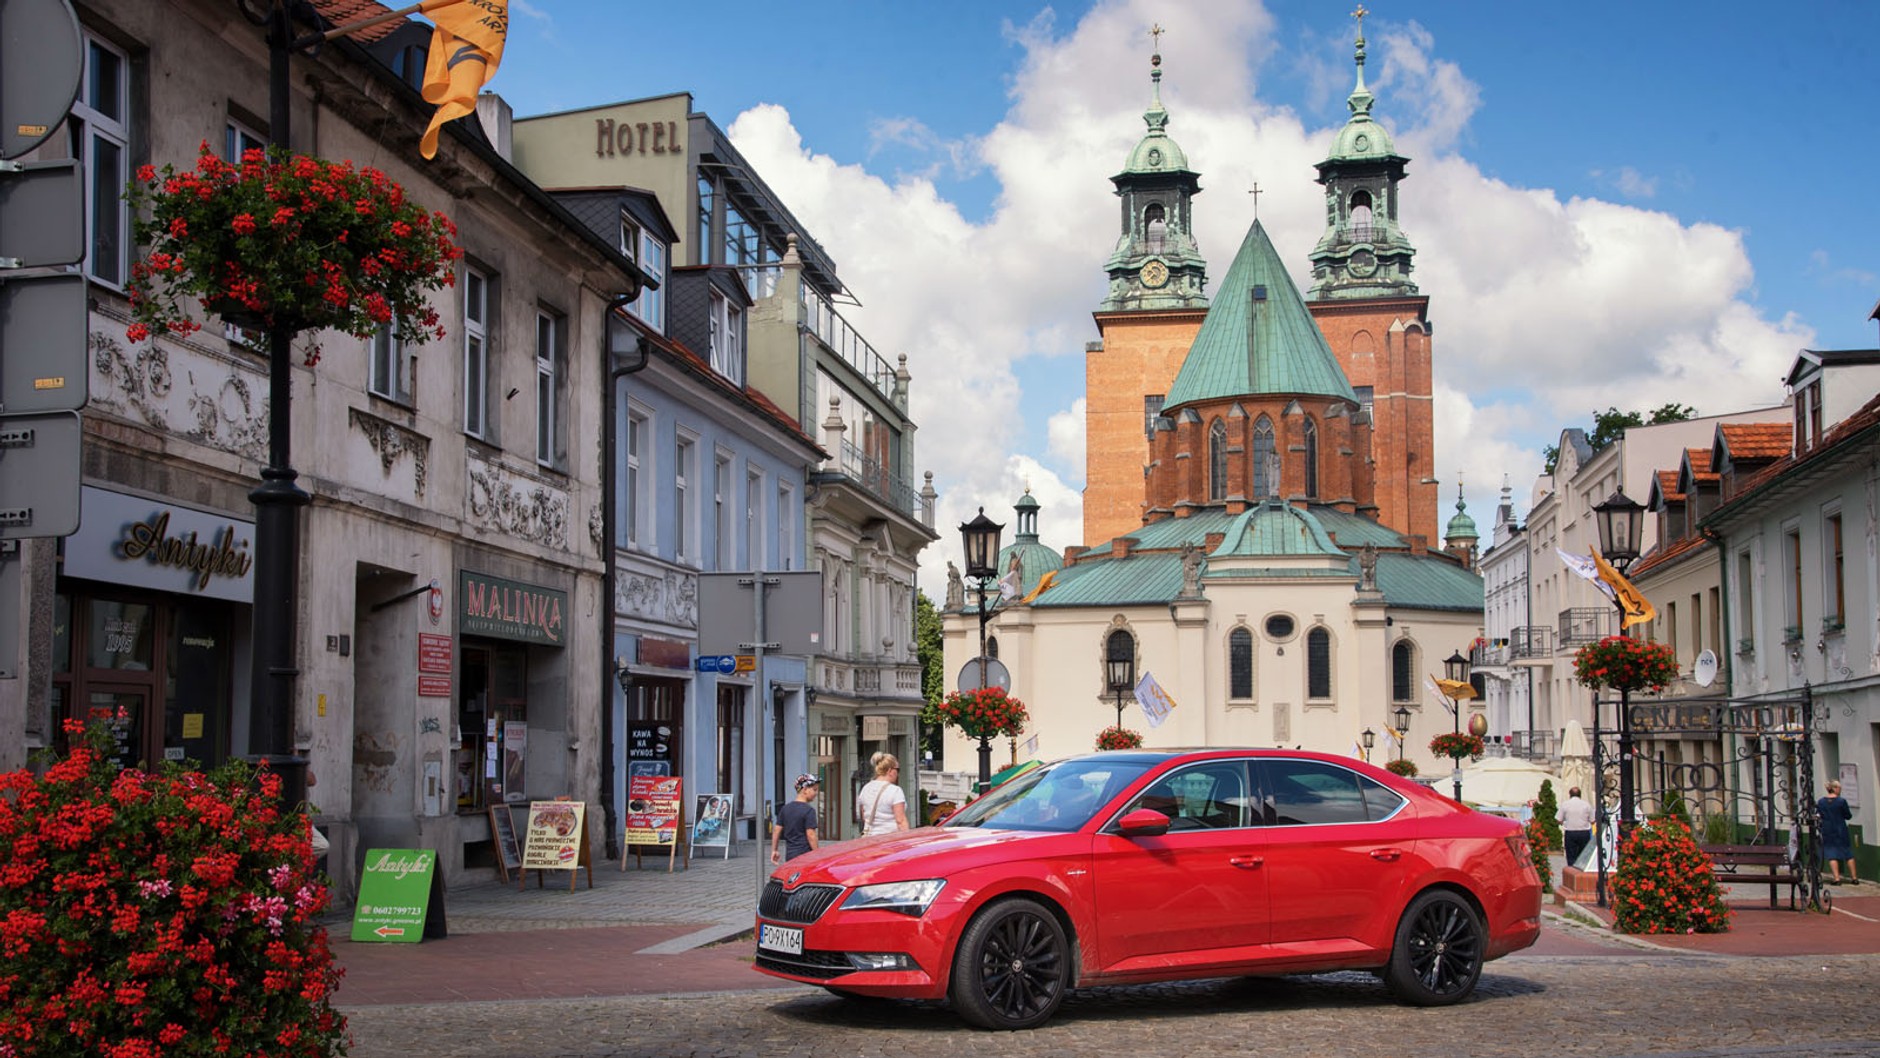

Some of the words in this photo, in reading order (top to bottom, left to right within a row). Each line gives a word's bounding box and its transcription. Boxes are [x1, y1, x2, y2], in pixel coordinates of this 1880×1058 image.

[596, 118, 682, 157] HOTEL
[124, 511, 252, 591] Antyki
[467, 580, 562, 641] MALINKA
[632, 730, 651, 738] KAWA
[637, 739, 647, 748] NA
[630, 749, 654, 757] WYNOS
[367, 853, 431, 880] Antyki
[373, 906, 421, 916] 0602799723
